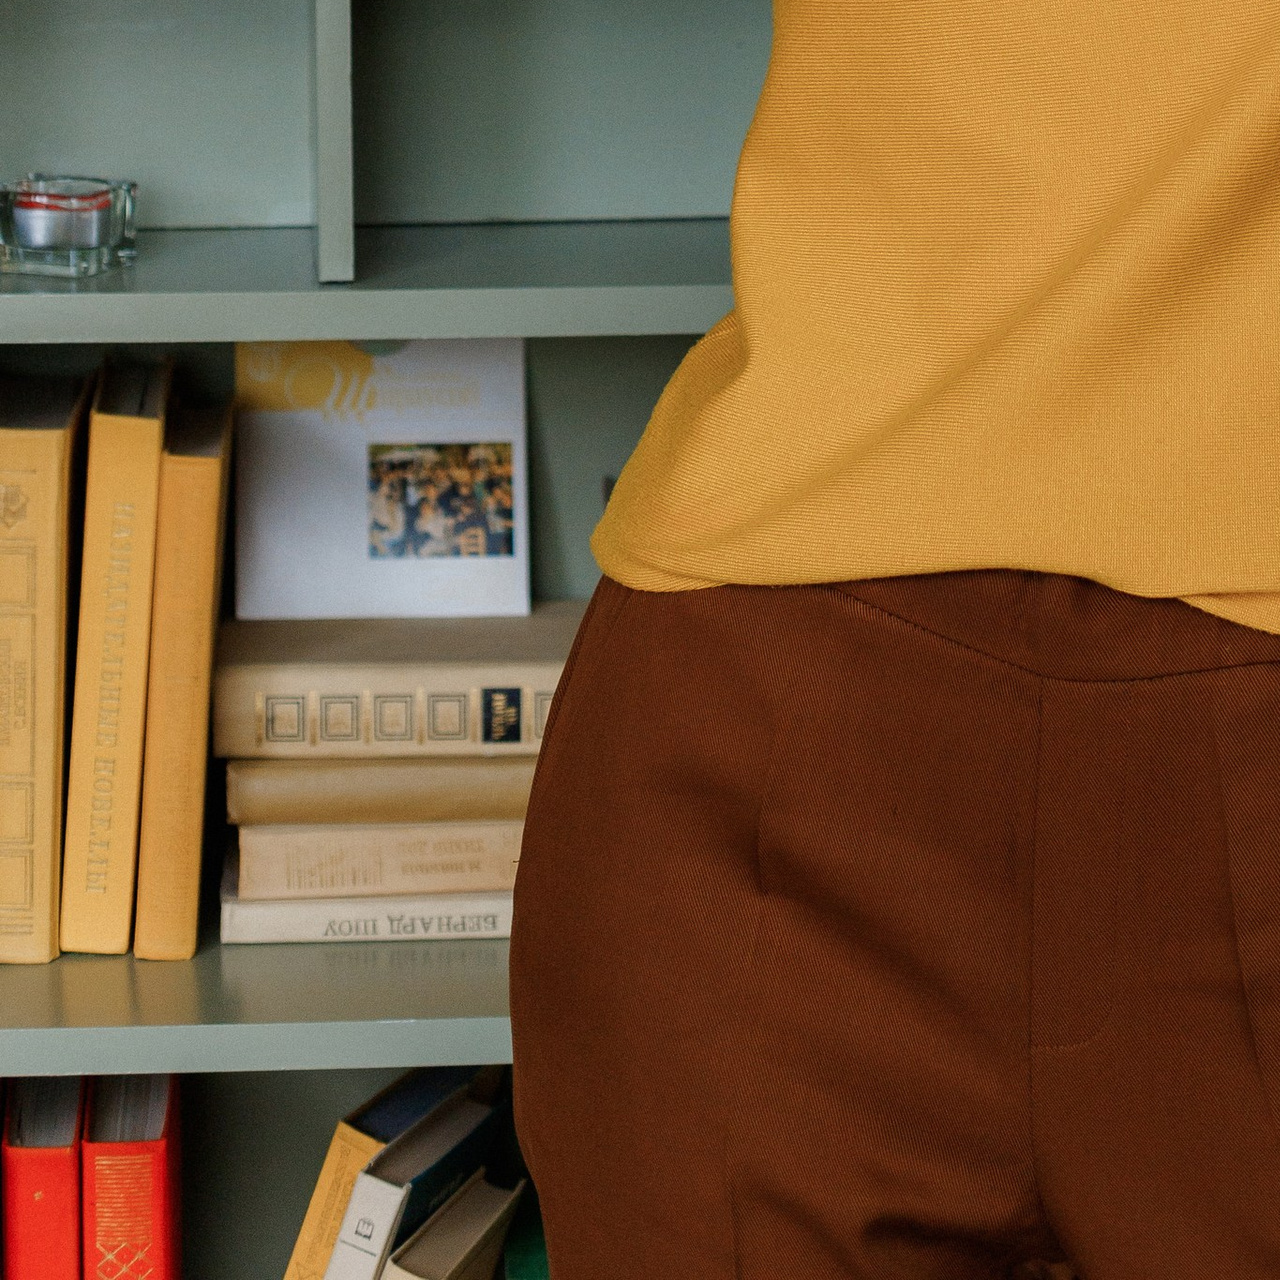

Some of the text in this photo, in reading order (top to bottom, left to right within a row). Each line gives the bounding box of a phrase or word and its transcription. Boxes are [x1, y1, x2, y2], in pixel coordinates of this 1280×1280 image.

[85, 502, 135, 895] НАЗИДАТЕЛЬНЫЕ НОВЕЛЛЫ
[322, 914, 499, 938] БЕРНАРД ШОУ
